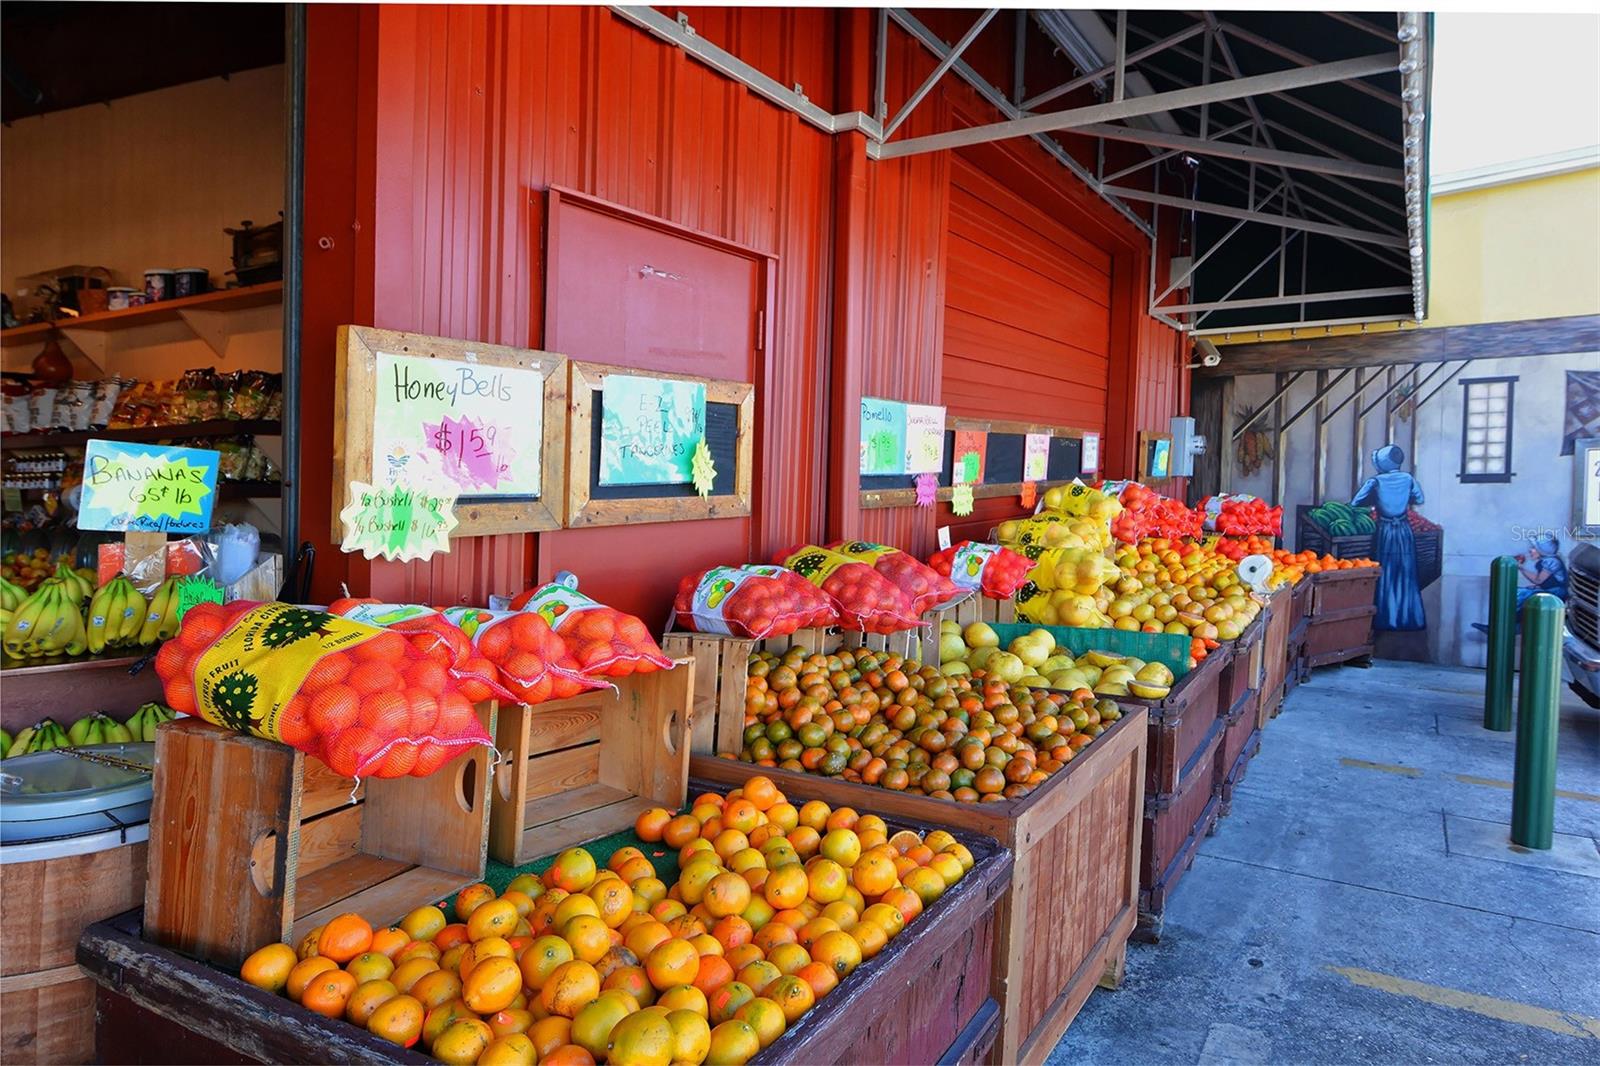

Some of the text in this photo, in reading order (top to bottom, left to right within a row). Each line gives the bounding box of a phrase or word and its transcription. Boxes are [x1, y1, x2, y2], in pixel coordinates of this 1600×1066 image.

[90, 455, 202, 485] BANANAS
[244, 621, 263, 652] FLORIDA
[334, 631, 363, 644] BUSHEL
[209, 659, 240, 678] FRUIT
